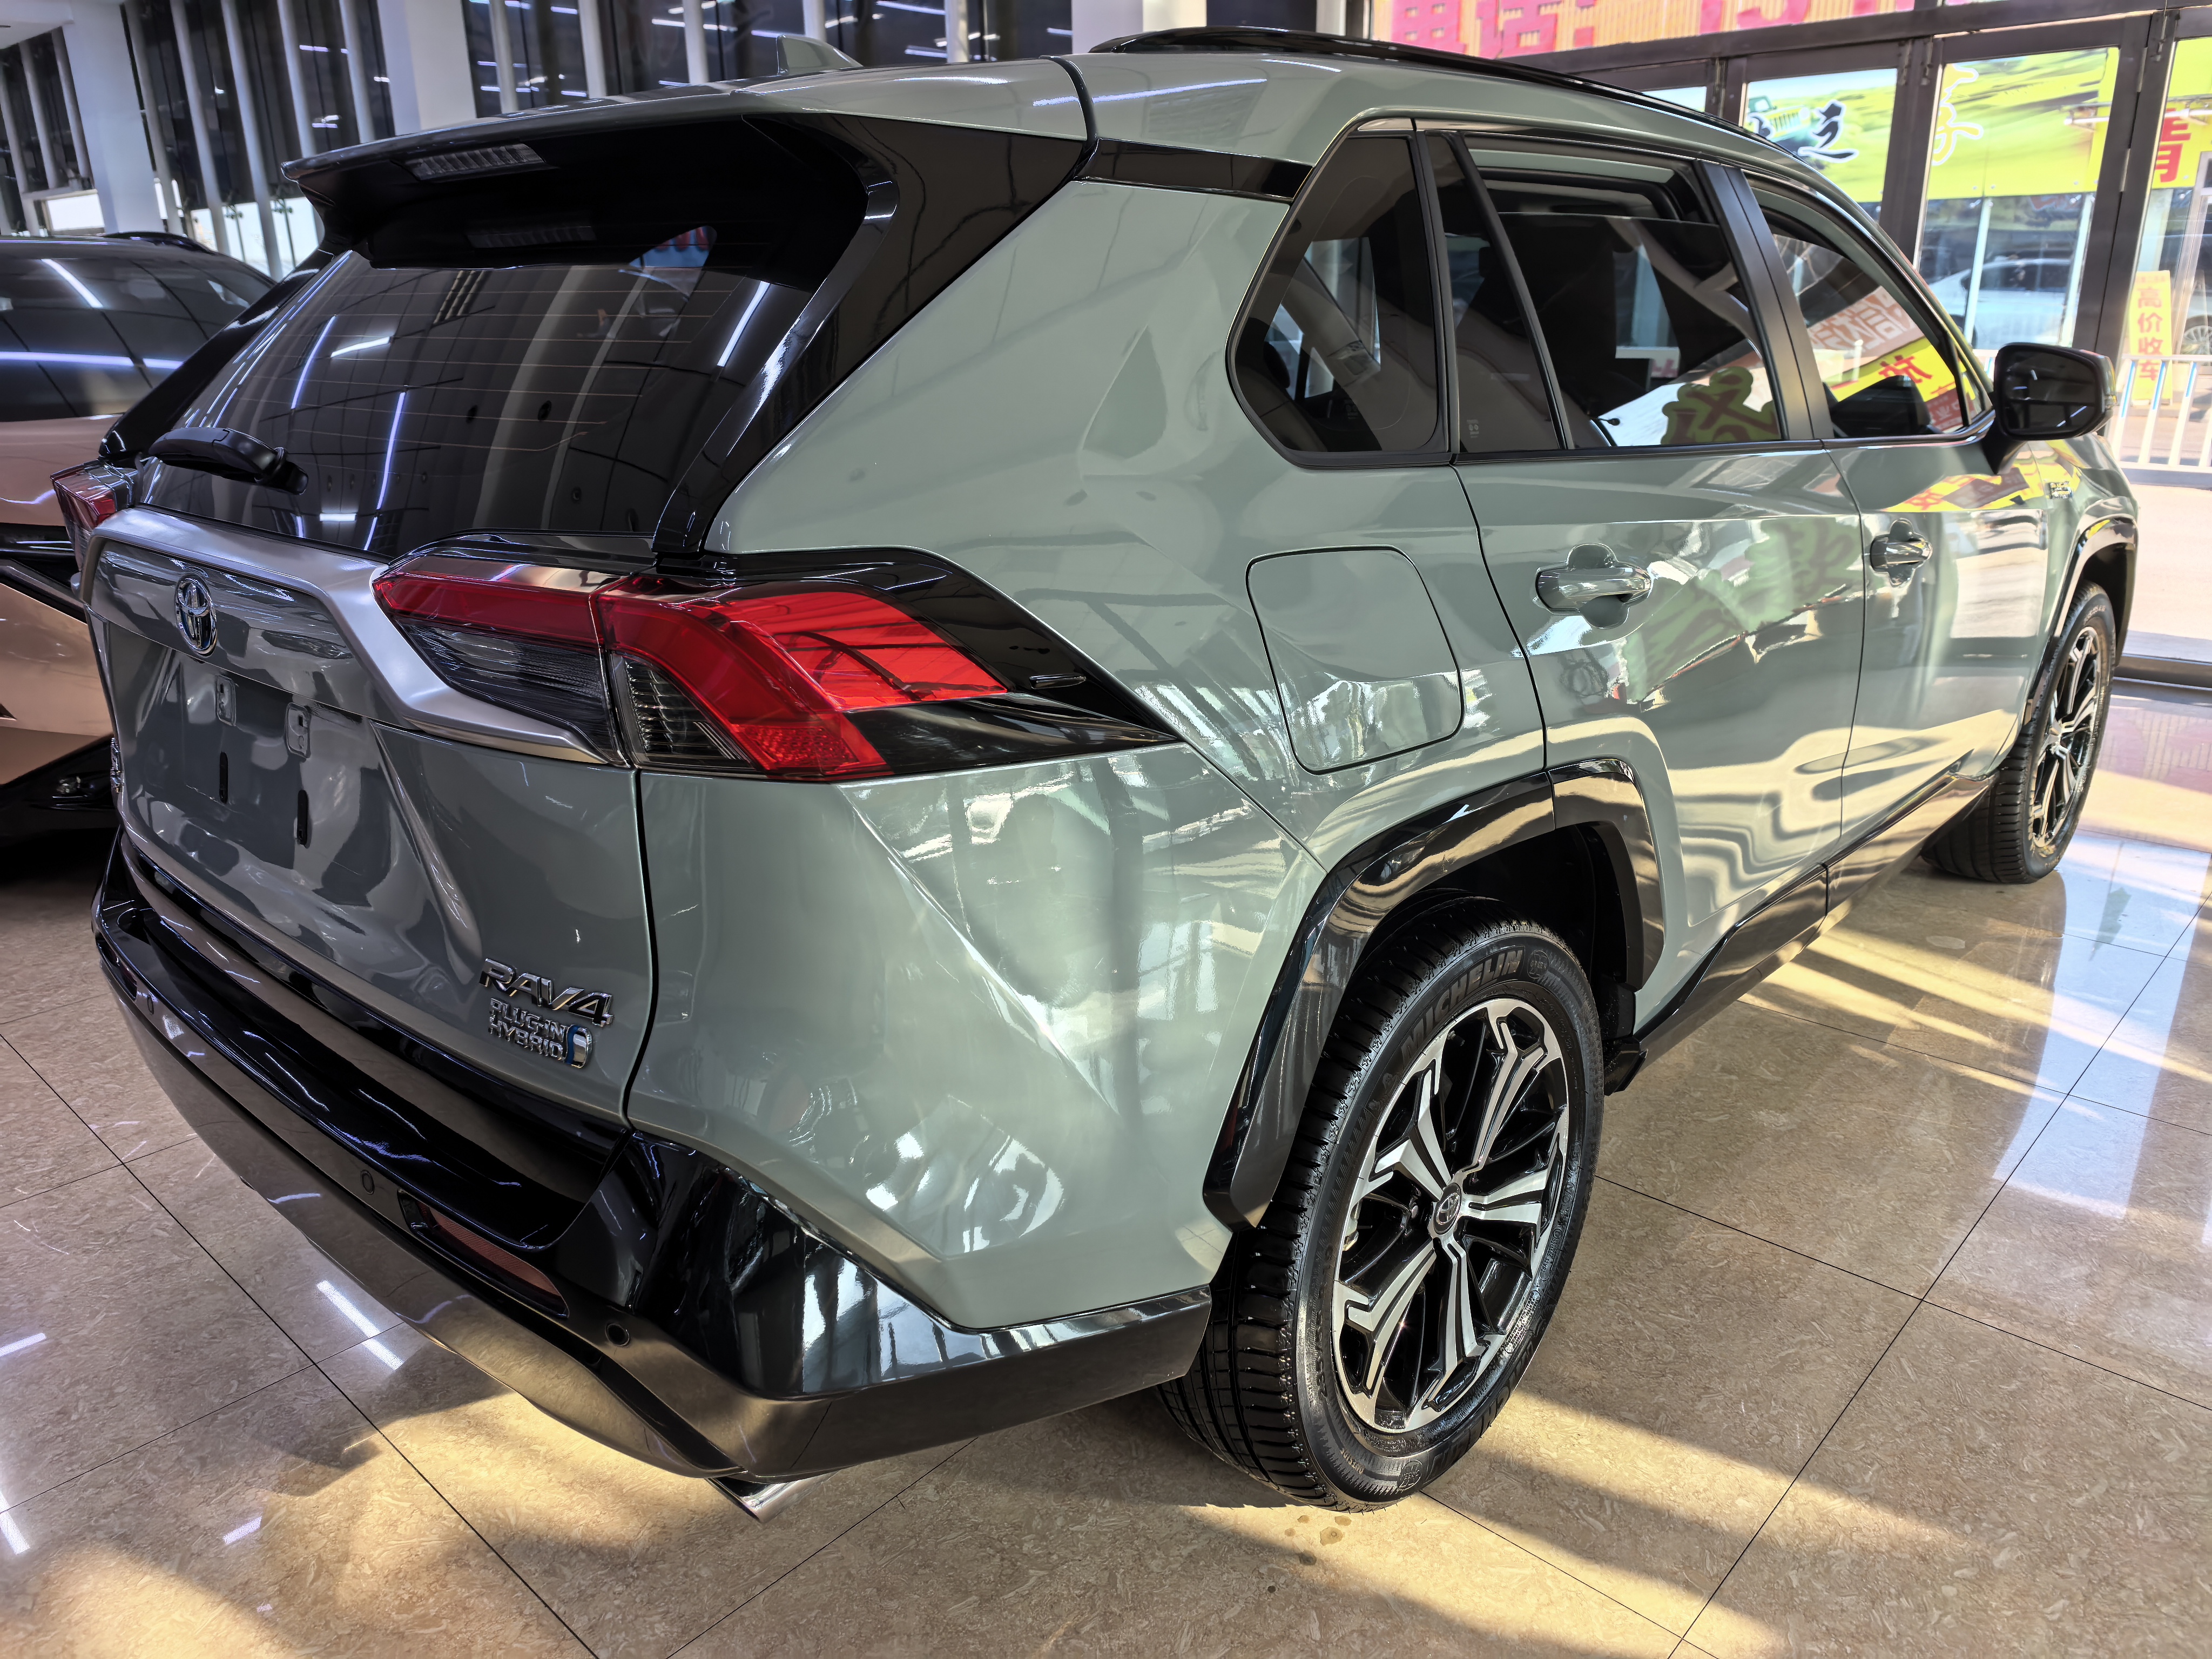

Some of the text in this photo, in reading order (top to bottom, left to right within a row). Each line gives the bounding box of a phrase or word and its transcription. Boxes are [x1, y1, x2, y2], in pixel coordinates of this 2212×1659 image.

[479, 958, 614, 1027] RAV4
[1401, 949, 1523, 1063] MICHELIN
[488, 1016, 564, 1061] HYBRID
